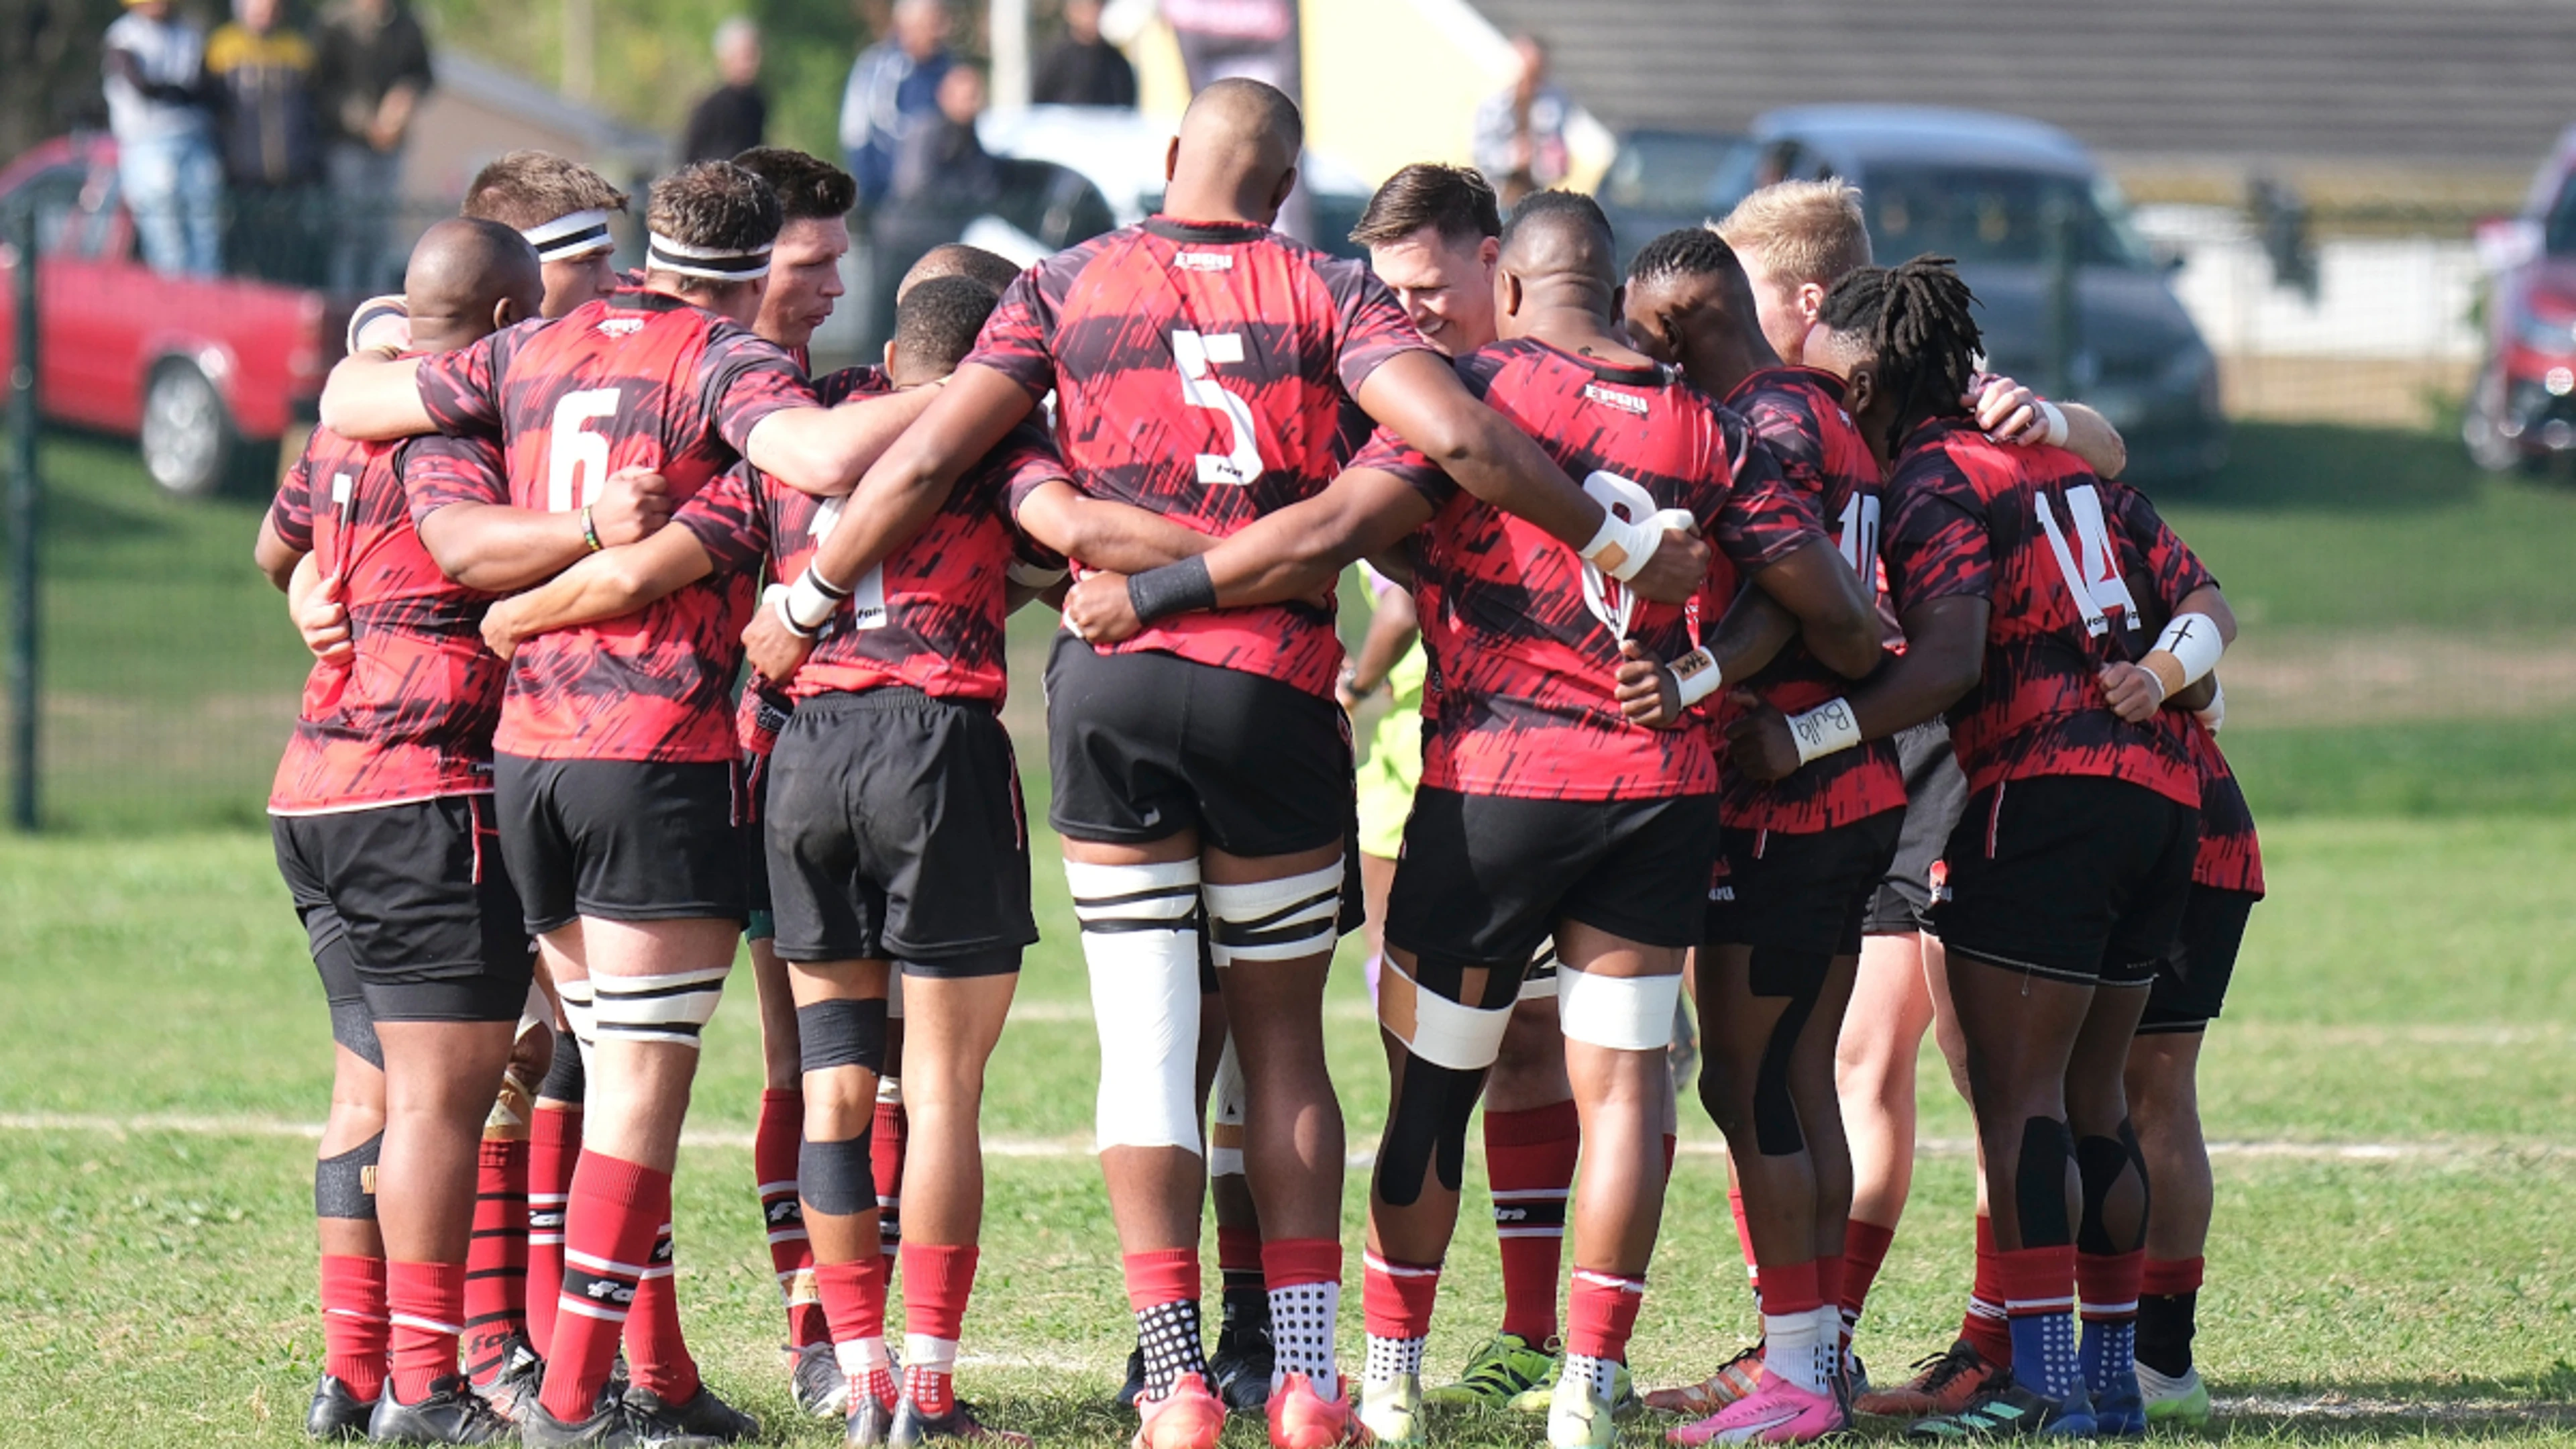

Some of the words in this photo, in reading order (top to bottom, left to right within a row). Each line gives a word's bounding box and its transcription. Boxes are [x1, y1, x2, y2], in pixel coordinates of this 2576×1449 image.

[548, 387, 621, 513] 6
[1172, 329, 1264, 486] 5
[1837, 490, 1881, 601] 10
[2035, 484, 2141, 637] 14
